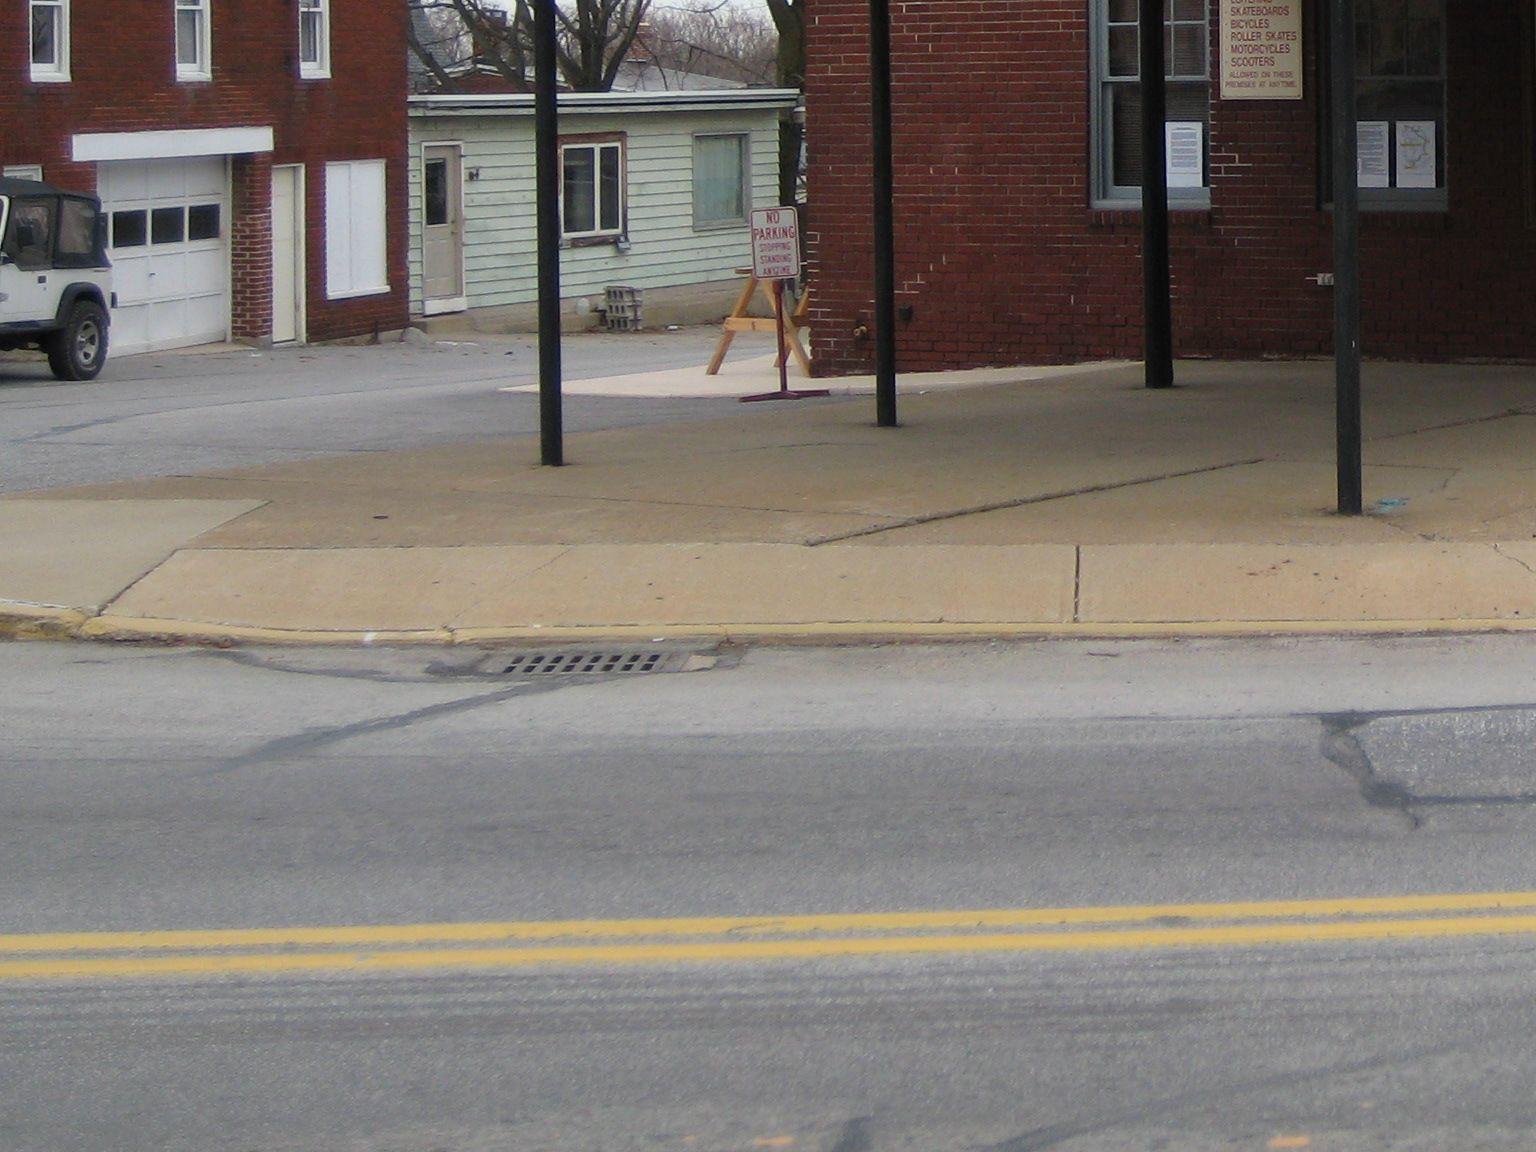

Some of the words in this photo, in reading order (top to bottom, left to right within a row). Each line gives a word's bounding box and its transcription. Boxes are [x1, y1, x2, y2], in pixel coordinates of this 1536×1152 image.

[1230, 6, 1290, 17] SKATEBOARDS
[1230, 19, 1270, 29] BICYCLES
[1230, 32, 1262, 42] ROLLER
[1265, 31, 1297, 41] SKATES
[1230, 44, 1290, 54] MOTORCYCLES
[1230, 56, 1275, 67] SCOOTERS
[766, 211, 780, 224] NO
[753, 226, 795, 240] PARKING
